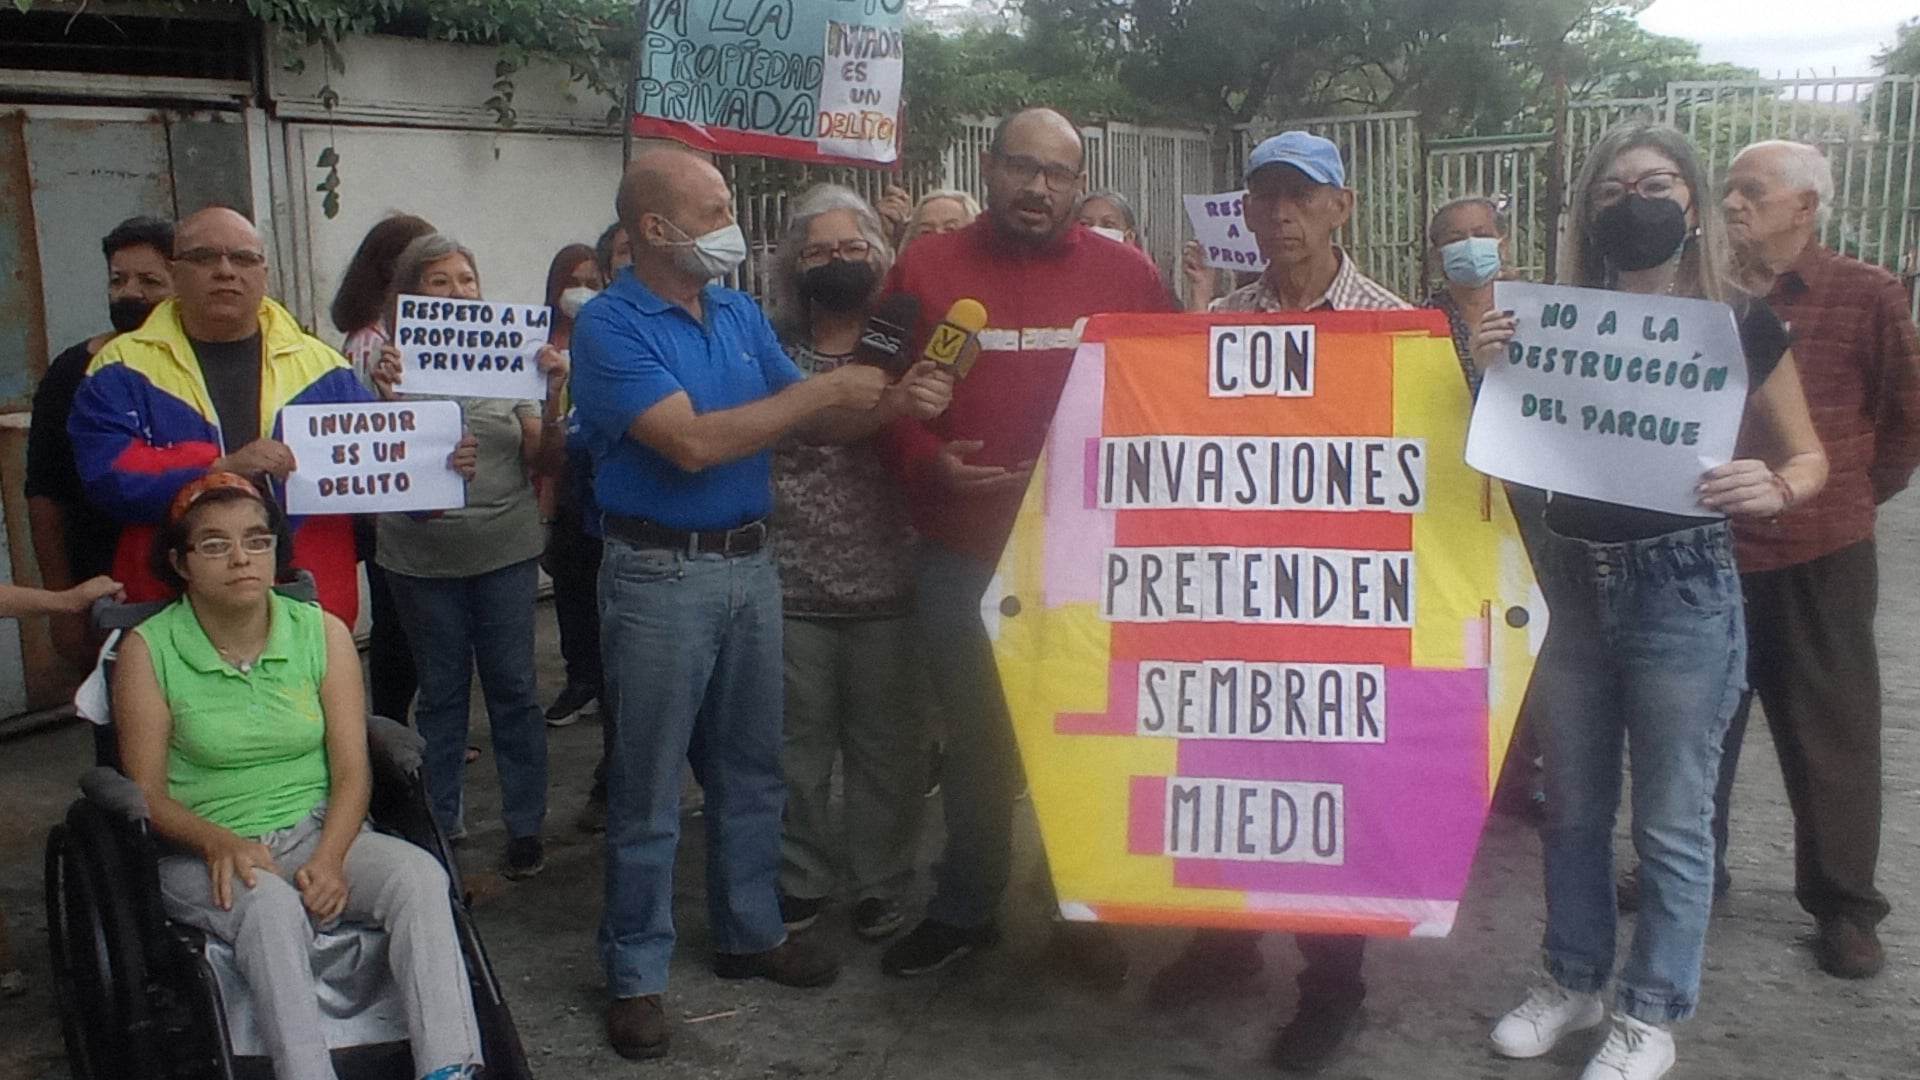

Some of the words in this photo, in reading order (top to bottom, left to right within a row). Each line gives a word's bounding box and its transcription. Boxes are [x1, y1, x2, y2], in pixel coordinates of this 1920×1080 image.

[650, 0, 688, 37] A
[709, 0, 793, 40] LA
[842, 61, 868, 82] ES
[633, 77, 815, 137] PRIVADA
[849, 88, 881, 105] UN
[818, 110, 895, 144] DELITO
[1227, 223, 1240, 239] A
[1208, 246, 1267, 266] PROP
[401, 300, 494, 324] RESPETO
[501, 307, 516, 325] A
[525, 309, 549, 328] LA
[1541, 303, 1578, 329] NO
[1597, 311, 1617, 335] A
[1642, 316, 1680, 342] LA
[399, 326, 524, 348] PROPIEDAD
[417, 351, 525, 373] PRIVADA
[1215, 330, 1308, 392] CON
[1508, 341, 1728, 392] DESTRUCCIÓN
[309, 410, 416, 437] INVADIR
[1521, 393, 1567, 424] DEL
[1581, 405, 1701, 446] PARQUE
[331, 444, 360, 466] ES
[373, 441, 406, 463] UN
[318, 472, 411, 497] DELITO
[1104, 441, 1421, 507] INVASIONES
[1106, 552, 1409, 622] PRETENDEN
[1142, 666, 1379, 738] SEMBRAR
[1170, 784, 1337, 857] MIEDO
